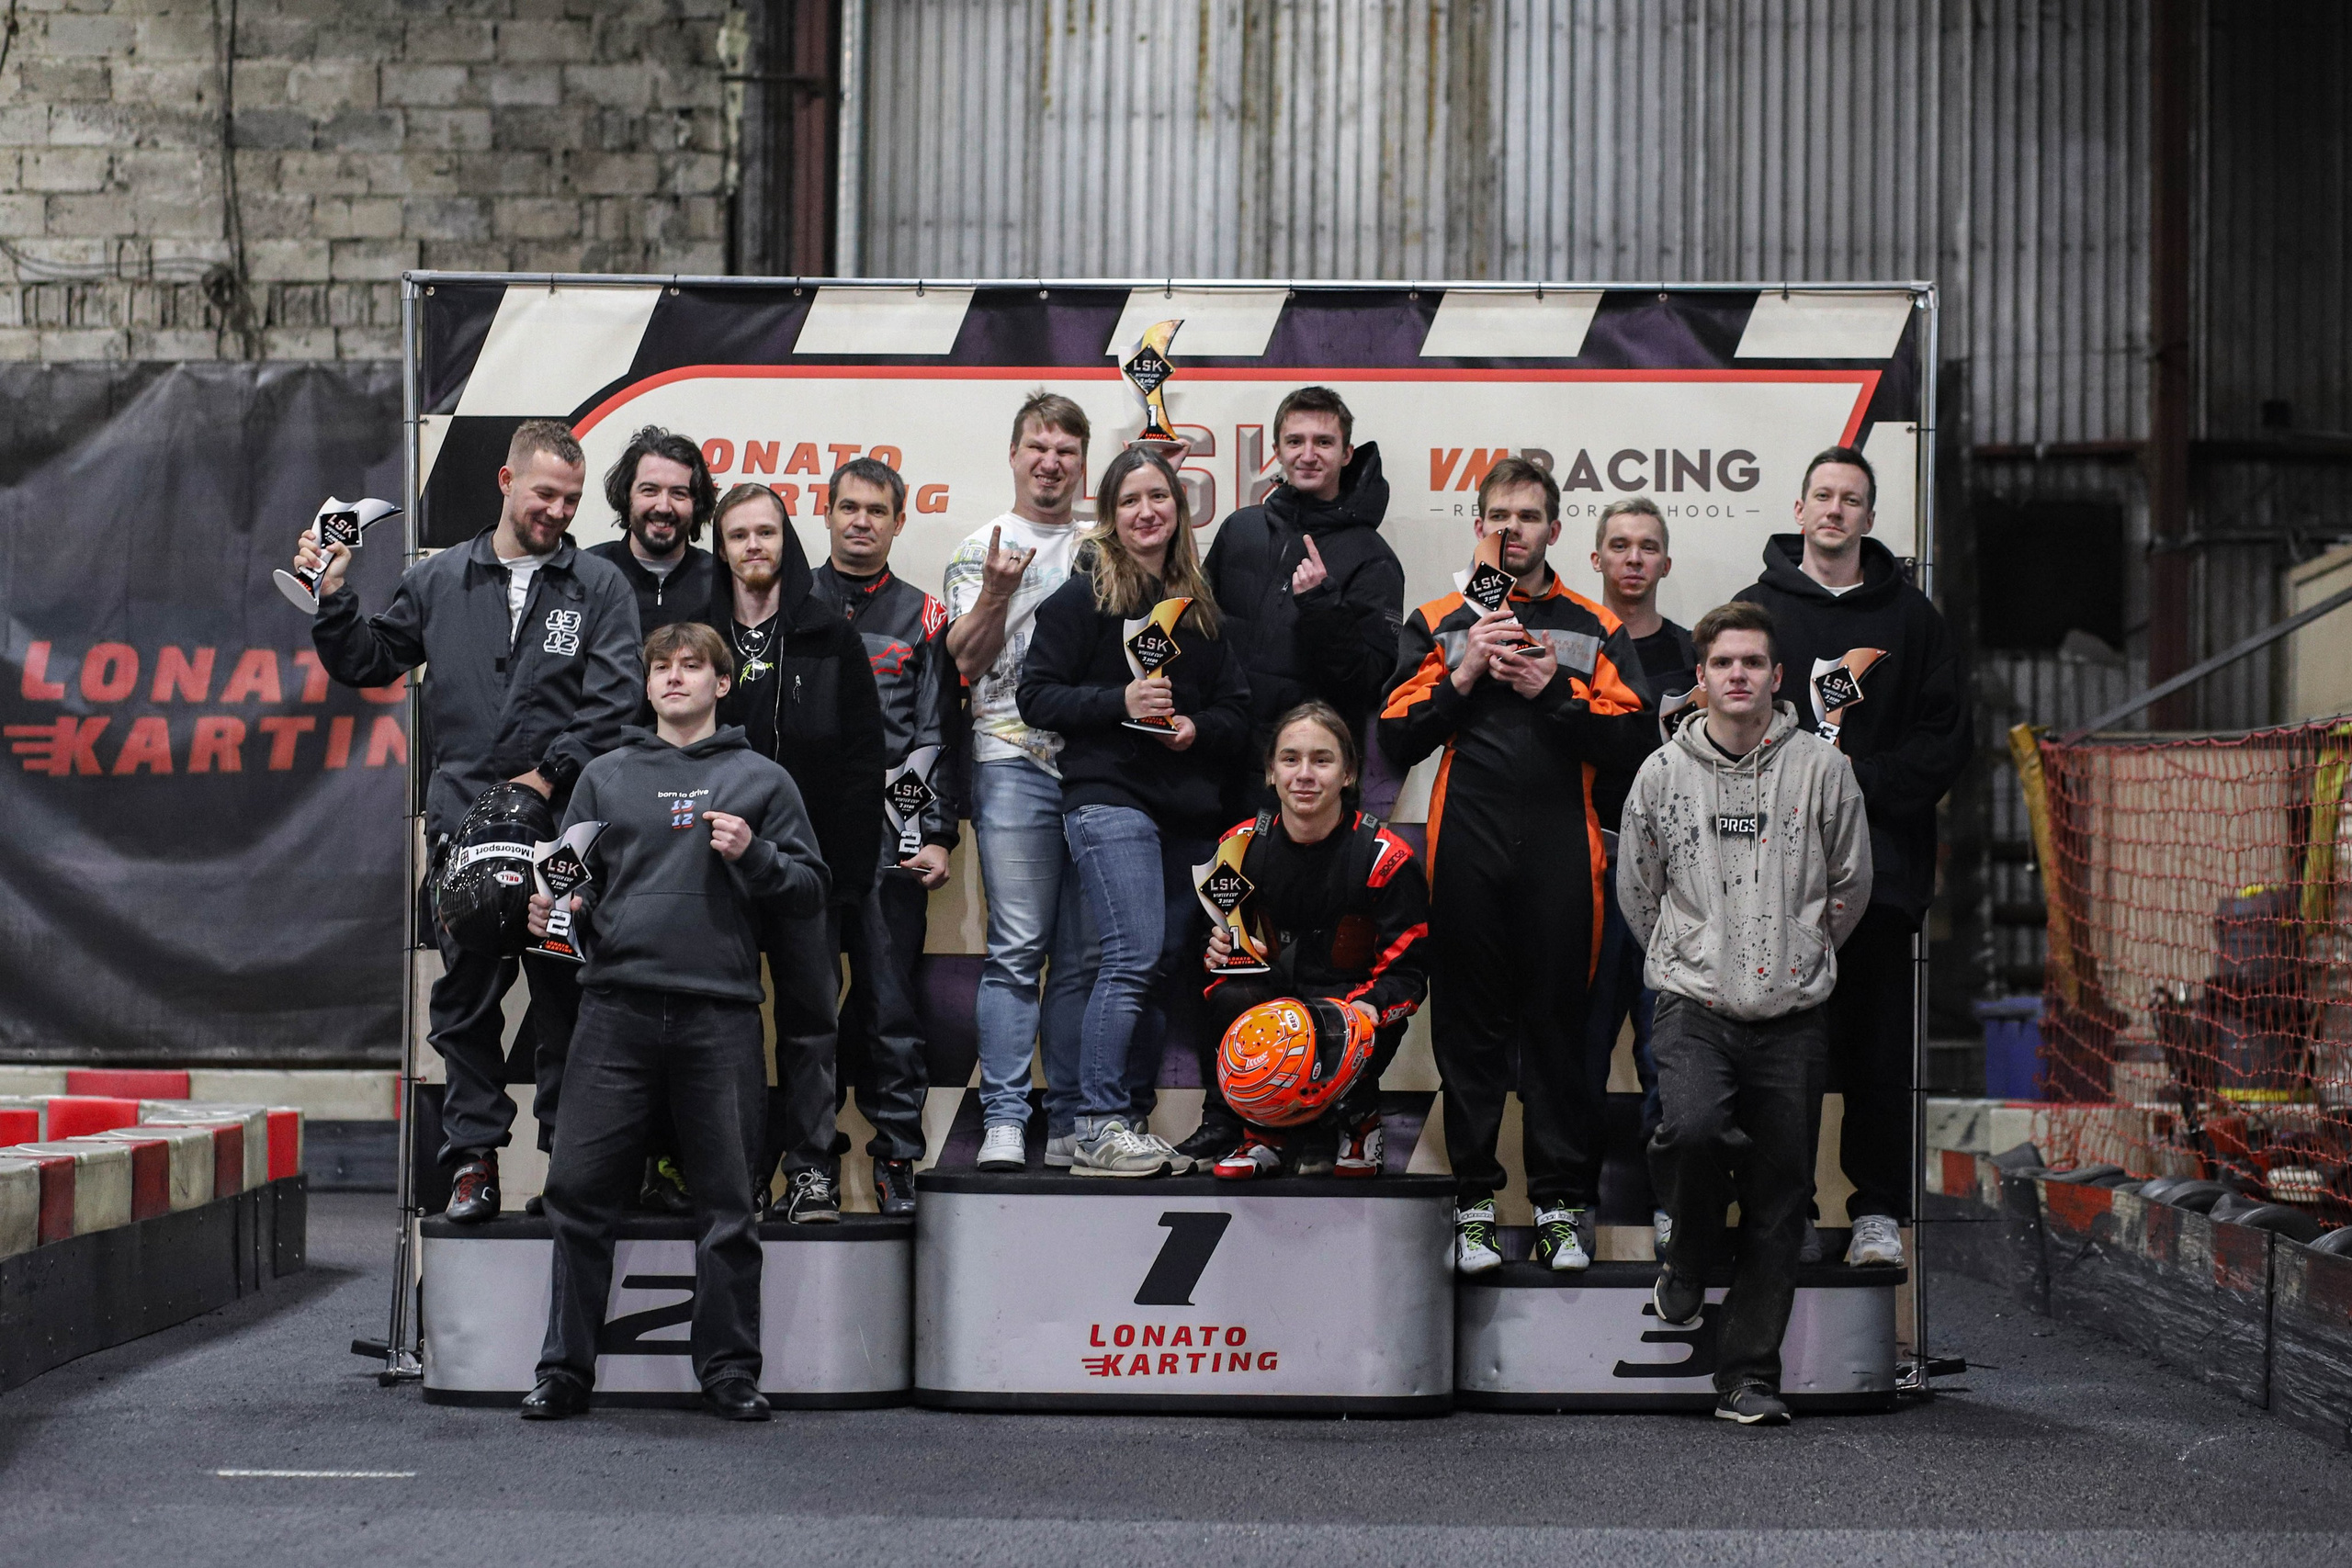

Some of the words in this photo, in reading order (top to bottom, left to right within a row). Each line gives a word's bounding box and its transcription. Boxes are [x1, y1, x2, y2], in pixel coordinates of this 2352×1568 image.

[1134, 359, 1163, 372] LSK
[1148, 405, 1157, 427] 1
[701, 438, 902, 474] ONATO
[327, 514, 356, 538] LSK
[1472, 573, 1504, 592] LSK
[546, 609, 582, 633] 13
[543, 631, 580, 656] 12
[1137, 636, 1169, 652] LSK
[1823, 674, 1854, 694] LSK
[46, 715, 407, 775] KARTIN
[689, 789, 709, 798] drive
[894, 784, 923, 797] LSK
[671, 799, 695, 814] 13
[672, 813, 695, 829] 12
[475, 844, 530, 858] Motorsport
[899, 829, 922, 853] 2
[547, 858, 580, 876] LSK
[1211, 878, 1241, 890] LSK
[546, 909, 571, 937] 2
[1229, 926, 1239, 950] 1
[1287, 1012, 1298, 1029] BELL
[1134, 1212, 1232, 1305] 1
[595, 1275, 696, 1355] 2
[1090, 1325, 1247, 1348] LONATO
[1101, 1351, 1278, 1377] KARTING
